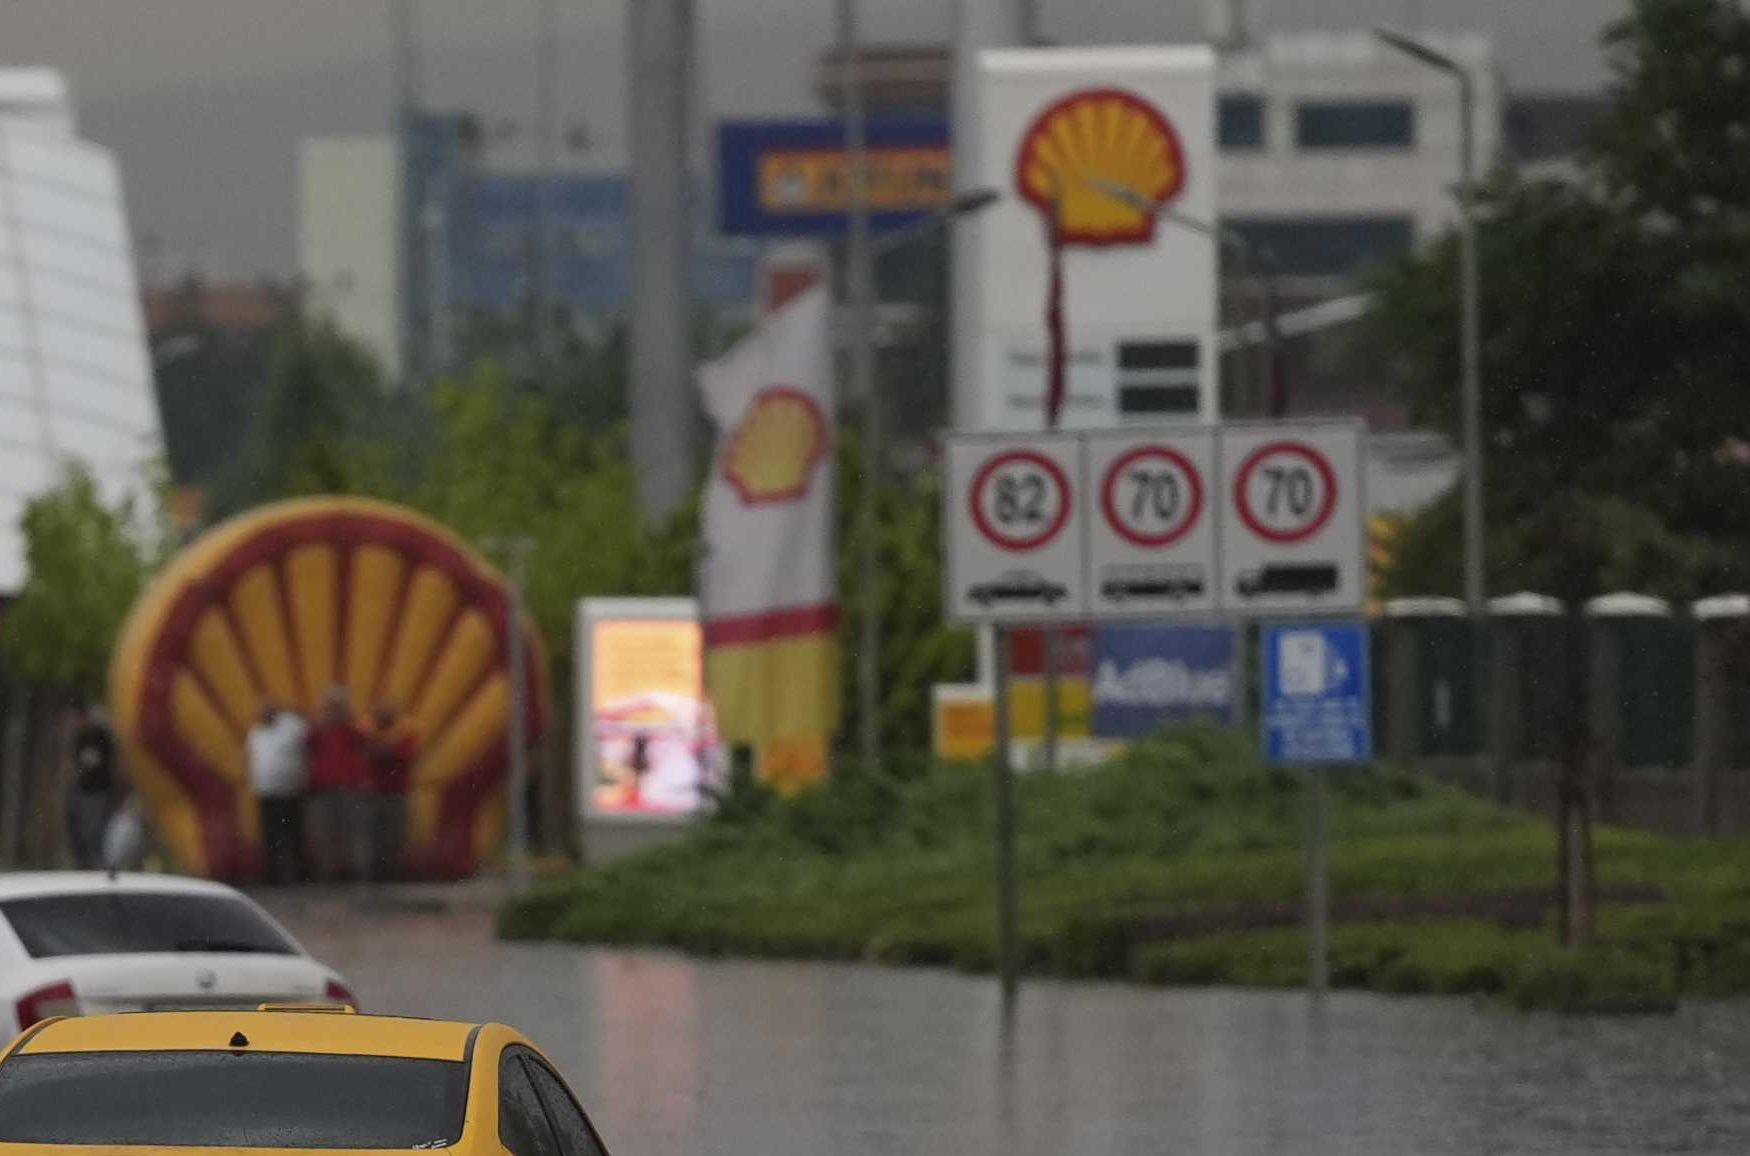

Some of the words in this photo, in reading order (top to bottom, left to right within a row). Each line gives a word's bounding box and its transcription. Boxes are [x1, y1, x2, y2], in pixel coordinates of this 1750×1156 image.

[993, 472, 1047, 525] 82
[1130, 469, 1179, 521] 70
[1262, 465, 1313, 517] 70
